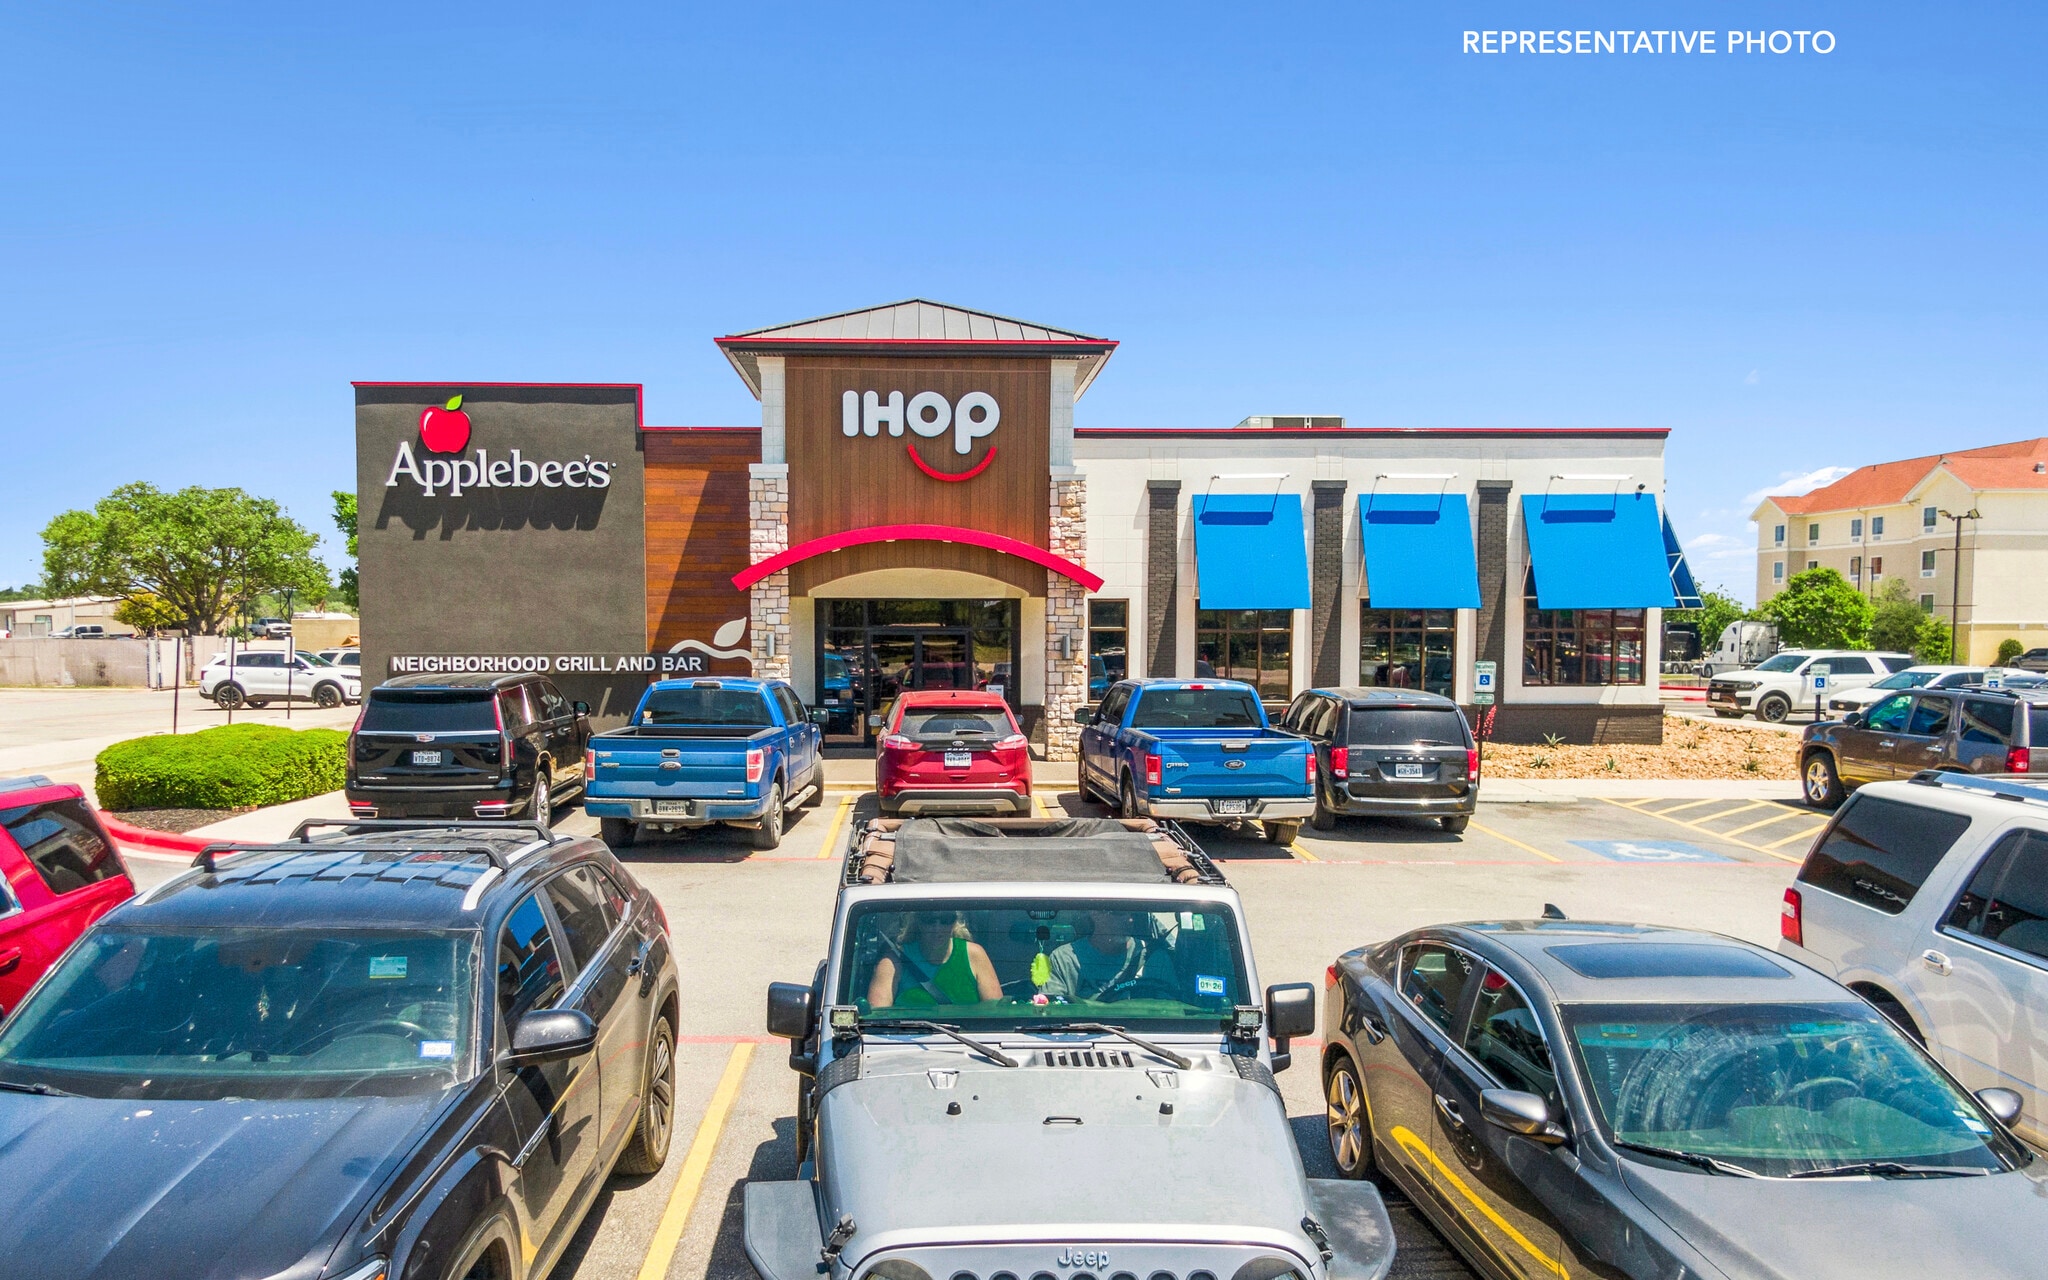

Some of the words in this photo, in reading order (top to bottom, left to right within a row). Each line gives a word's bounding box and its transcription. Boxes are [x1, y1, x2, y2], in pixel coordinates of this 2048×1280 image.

[385, 441, 612, 497] Applebee's
[392, 656, 550, 672] NEIGHBORHOOD
[555, 656, 611, 672] GRILL
[616, 656, 656, 672] AND
[662, 656, 702, 672] BAR
[1114, 979, 1137, 991] Jeep
[1057, 1246, 1110, 1272] Jeep
